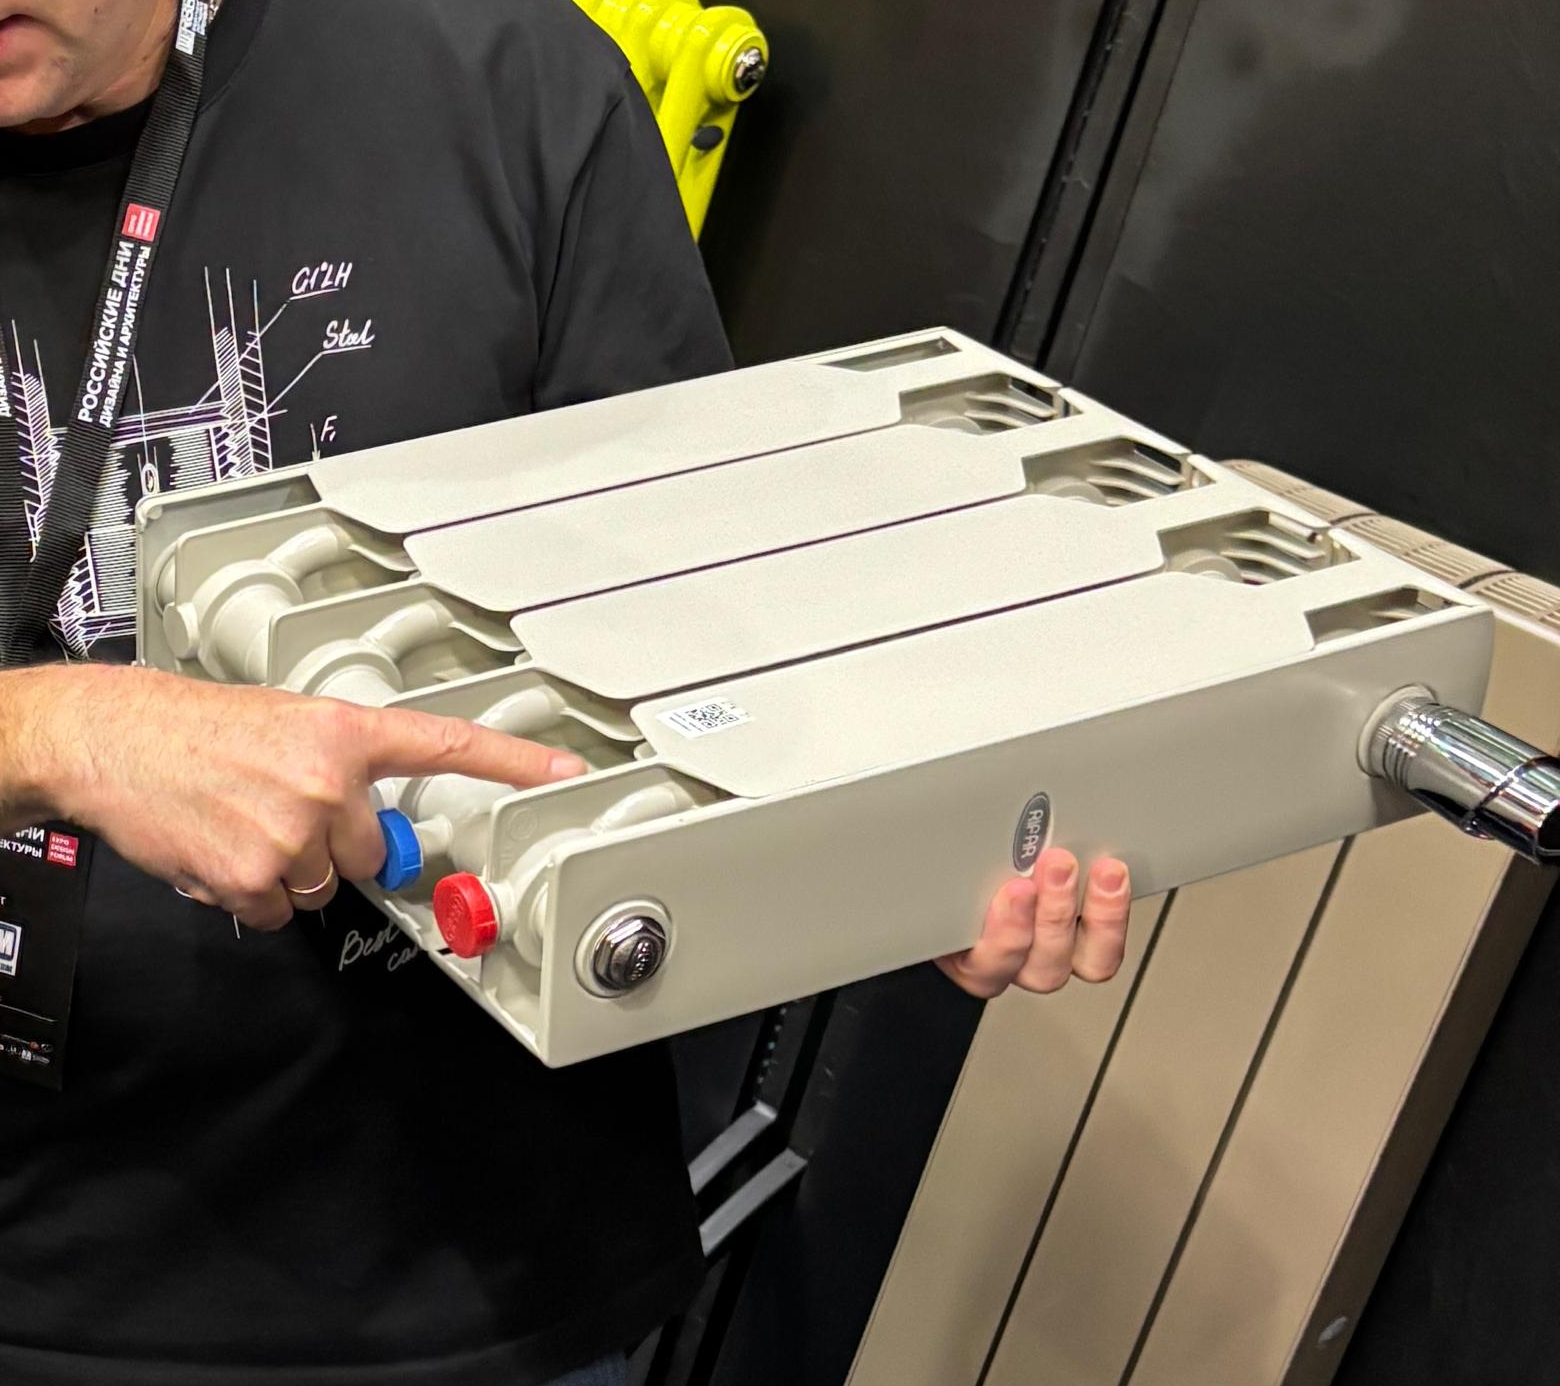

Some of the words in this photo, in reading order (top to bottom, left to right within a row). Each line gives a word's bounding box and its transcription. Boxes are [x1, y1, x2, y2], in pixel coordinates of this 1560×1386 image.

[119, 246, 151, 347] АРХИТЕКТУРЫ
[77, 288, 123, 423] РОССИЙСКИЕ
[111, 241, 134, 288] ДНИ
[117, 350, 128, 363] И
[98, 365, 126, 428] ДИЗАЙНА
[1020, 809, 1044, 859] RIFAR
